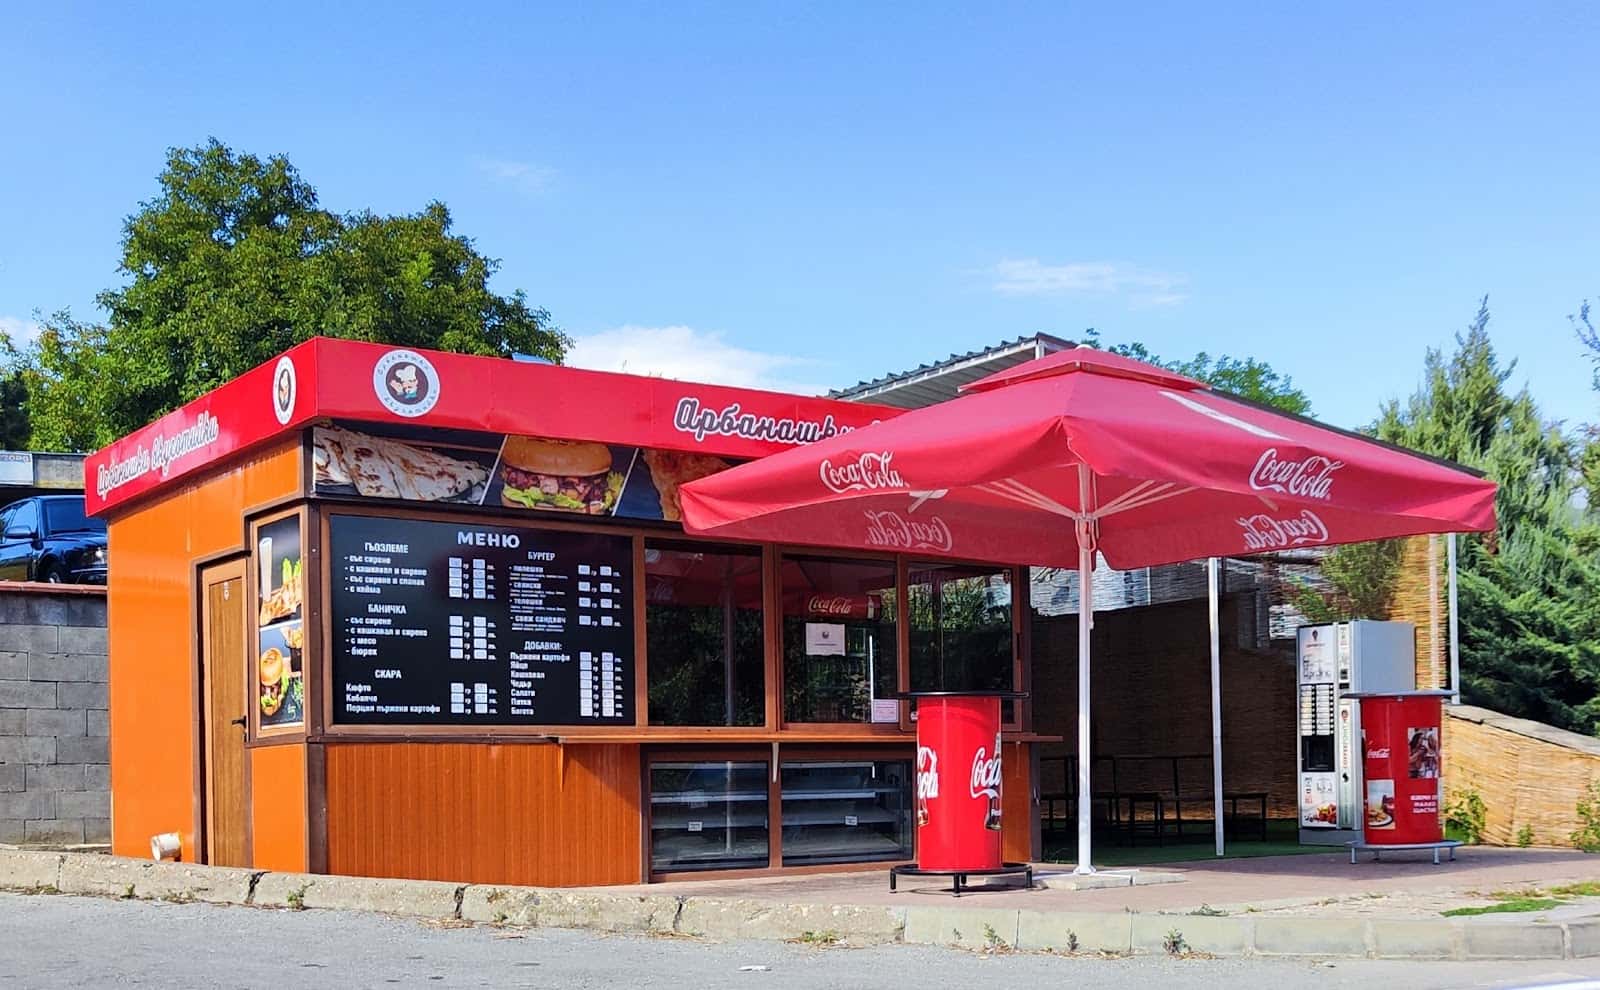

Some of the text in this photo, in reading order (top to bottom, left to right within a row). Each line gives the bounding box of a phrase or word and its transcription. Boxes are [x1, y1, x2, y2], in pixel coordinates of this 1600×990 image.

[820, 450, 905, 493] Coca-Cola
[1249, 448, 1345, 499] Coca-Cola
[457, 530, 521, 549] МЕНЮ
[527, 551, 556, 561] БУРГЕР
[368, 603, 407, 614] БАНИЧКА
[808, 595, 852, 614] Coca-Cola
[524, 640, 563, 651] ДОБАВКИ:
[374, 669, 402, 679] СКАРА
